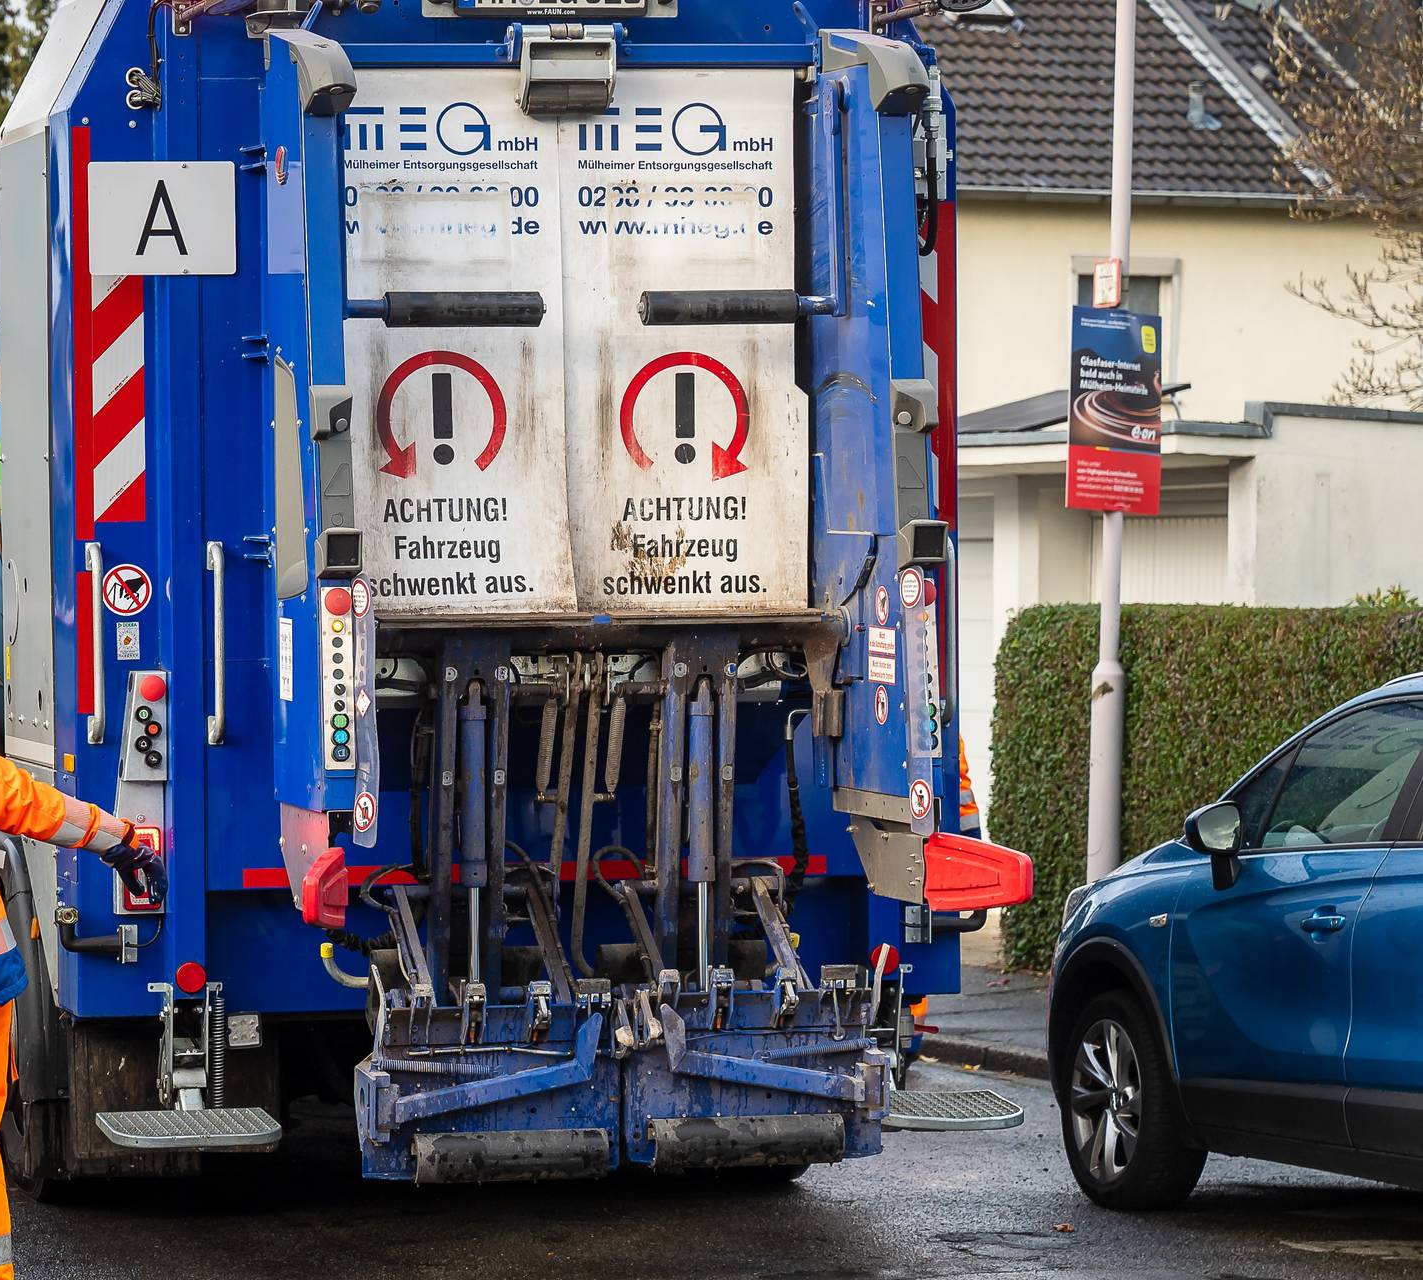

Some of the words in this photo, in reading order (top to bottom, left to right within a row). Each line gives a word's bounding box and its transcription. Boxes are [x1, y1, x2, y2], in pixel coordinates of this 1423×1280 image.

[497, 137, 539, 152] mbH
[732, 138, 774, 152] mbH
[344, 159, 401, 170] Mülheimer
[403, 159, 539, 172] Entsorgungsgesellschaft
[577, 159, 635, 170] Mülheimer
[638, 160, 774, 172] Entsorgungsgesellschaft
[135, 179, 188, 255] A
[383, 498, 507, 523] ACHTUNG!
[622, 496, 746, 522] ACHTUNG!
[394, 536, 501, 563] Fahrzeug
[633, 533, 738, 562] Fahrzeug
[370, 572, 477, 597] schwenkt
[485, 574, 534, 594] aus.
[603, 571, 712, 595] schwenkt
[720, 573, 767, 593] aus.
